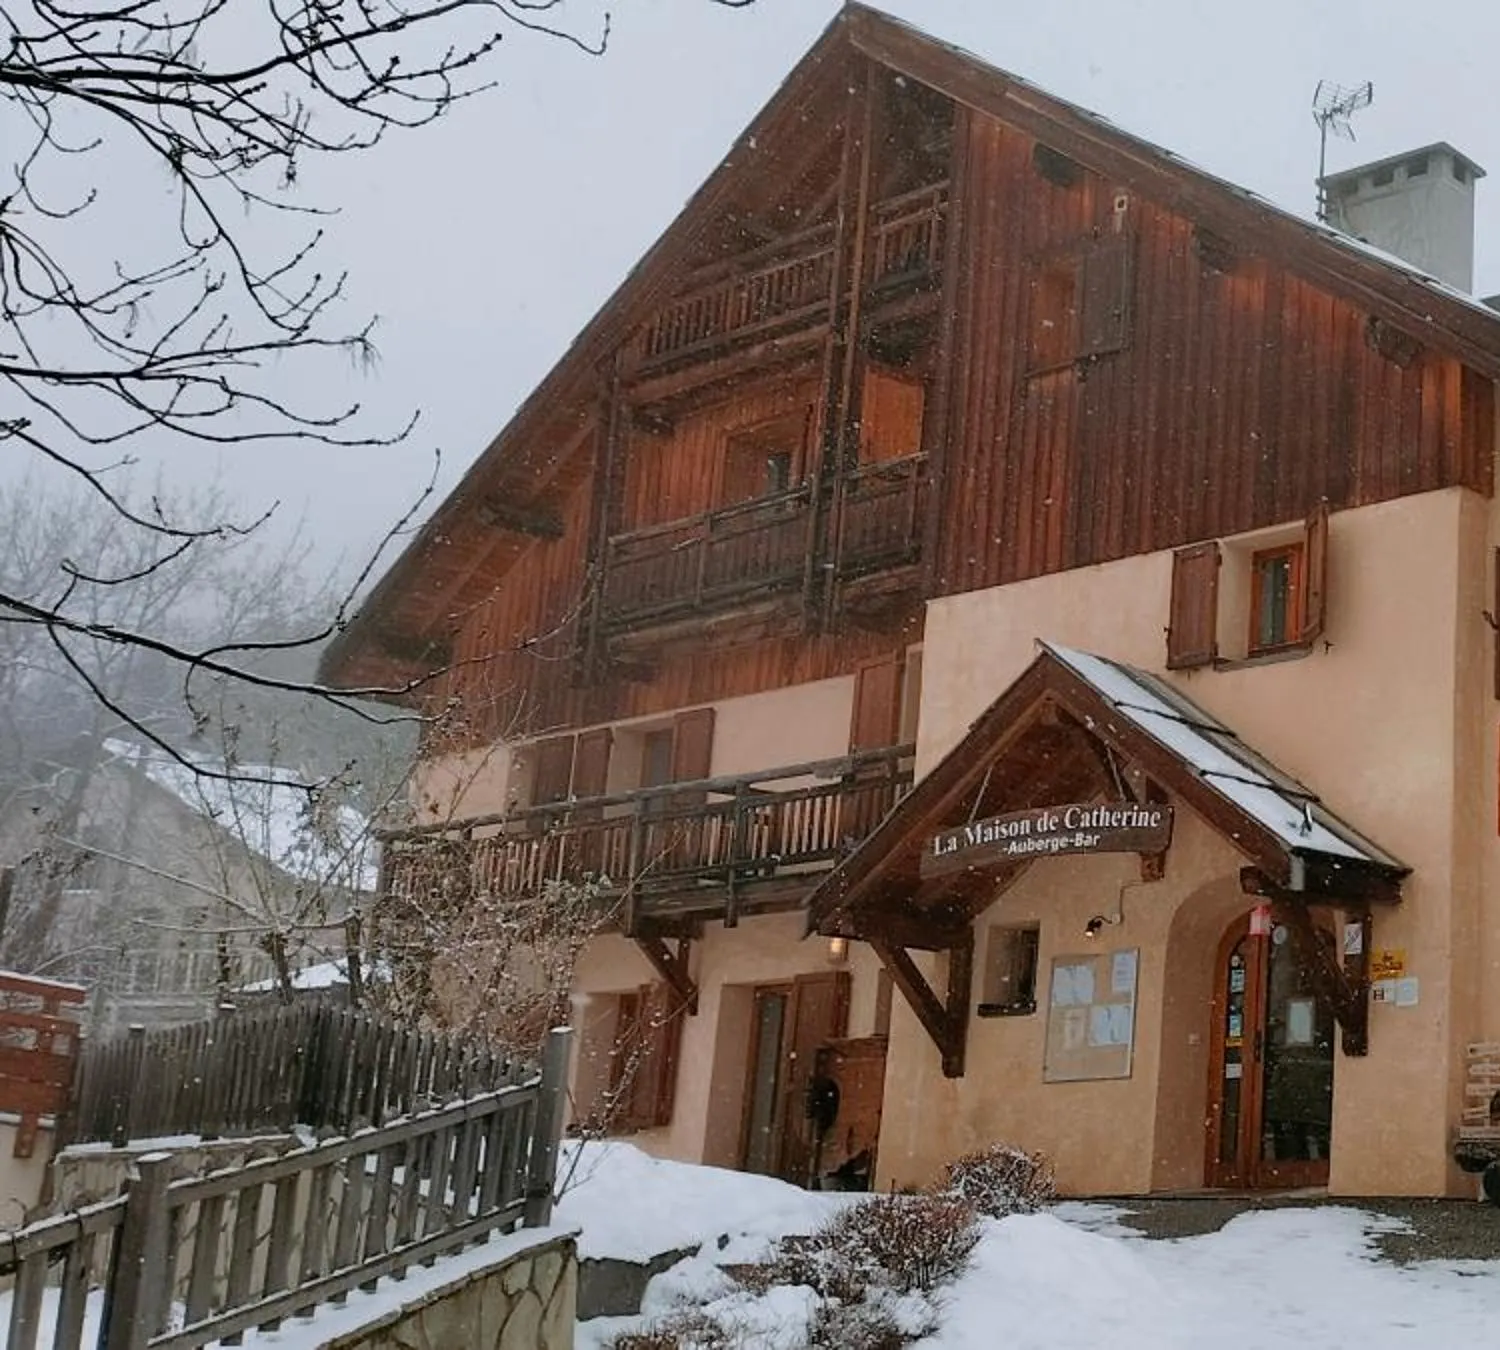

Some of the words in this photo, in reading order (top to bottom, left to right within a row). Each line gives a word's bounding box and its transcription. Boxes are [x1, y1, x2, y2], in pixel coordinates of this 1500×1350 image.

[933, 835, 957, 856] La
[963, 819, 1031, 848] Maison
[1036, 811, 1059, 833] de
[1064, 805, 1161, 830] Catherine
